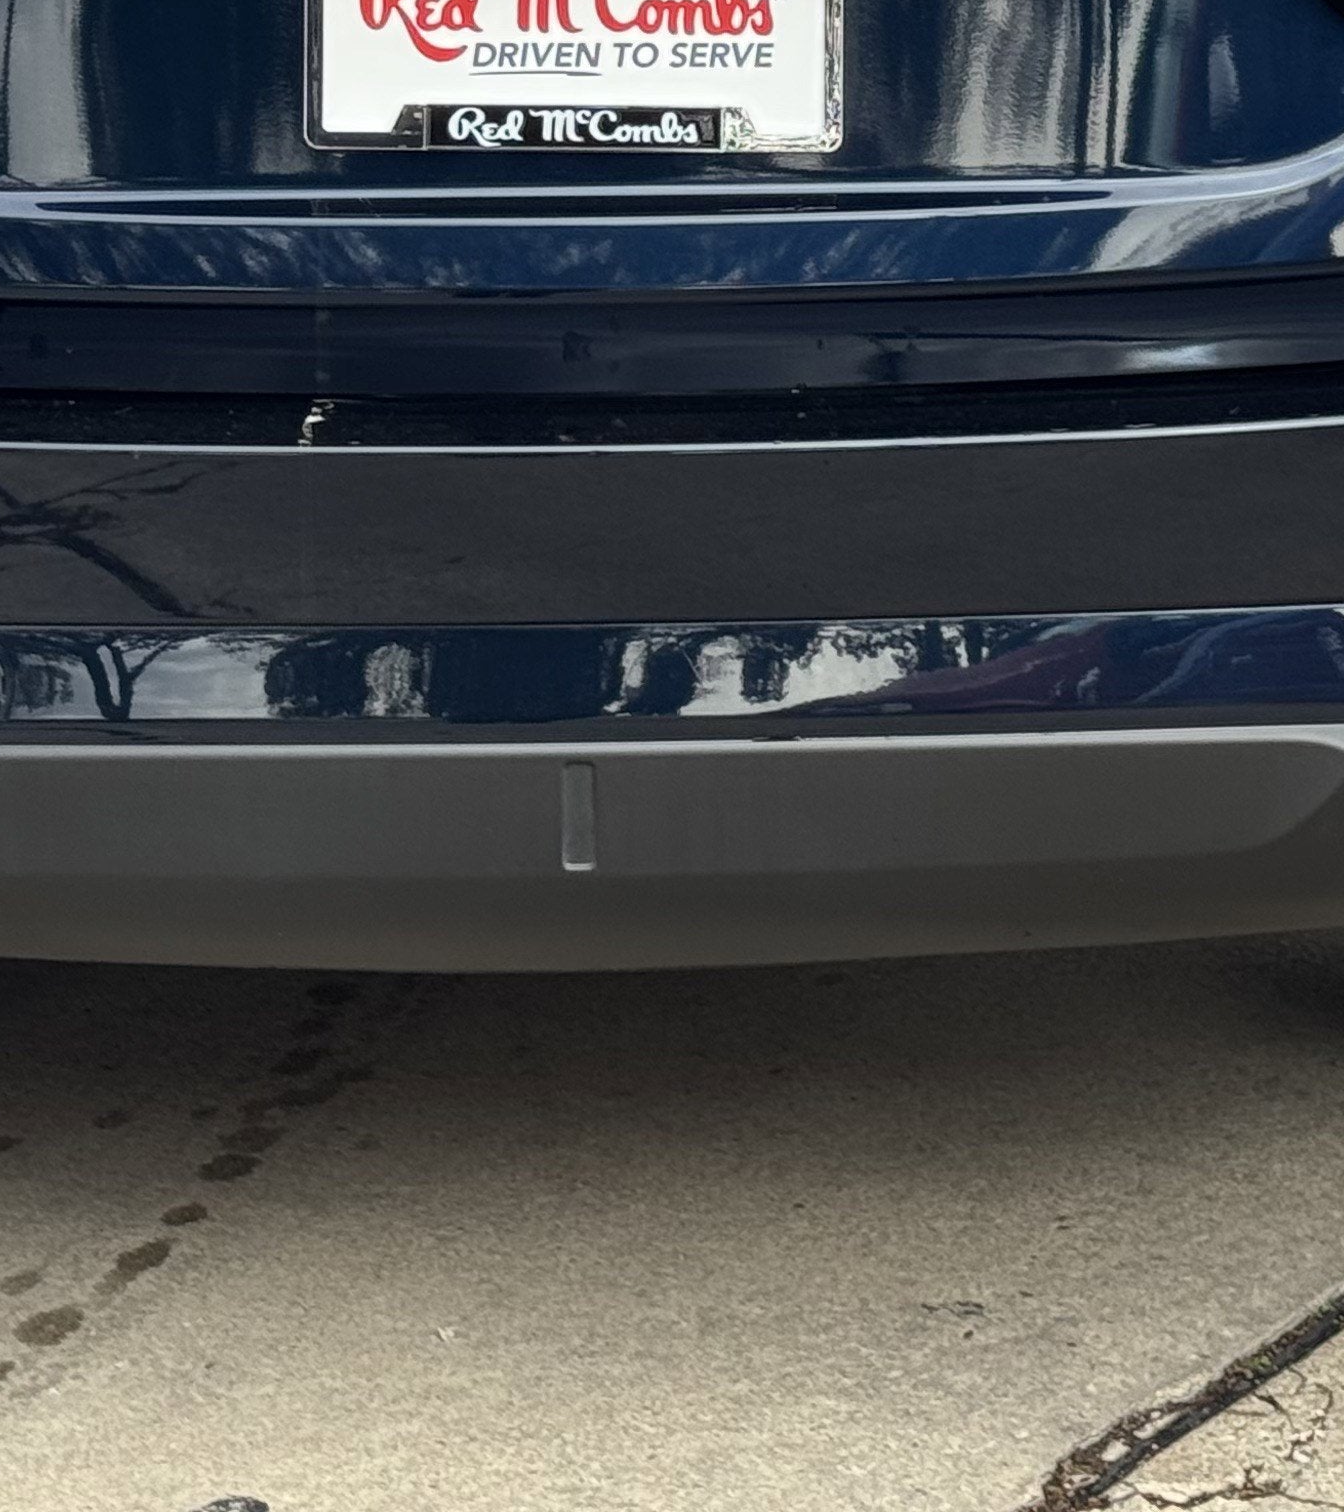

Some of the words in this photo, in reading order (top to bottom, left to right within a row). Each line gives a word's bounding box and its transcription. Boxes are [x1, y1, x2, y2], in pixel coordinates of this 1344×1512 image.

[472, 41, 602, 68] DRIVEN
[613, 41, 660, 68] TO
[668, 42, 774, 68] SERVE
[447, 107, 524, 148] Red
[528, 109, 698, 143] McCombs
